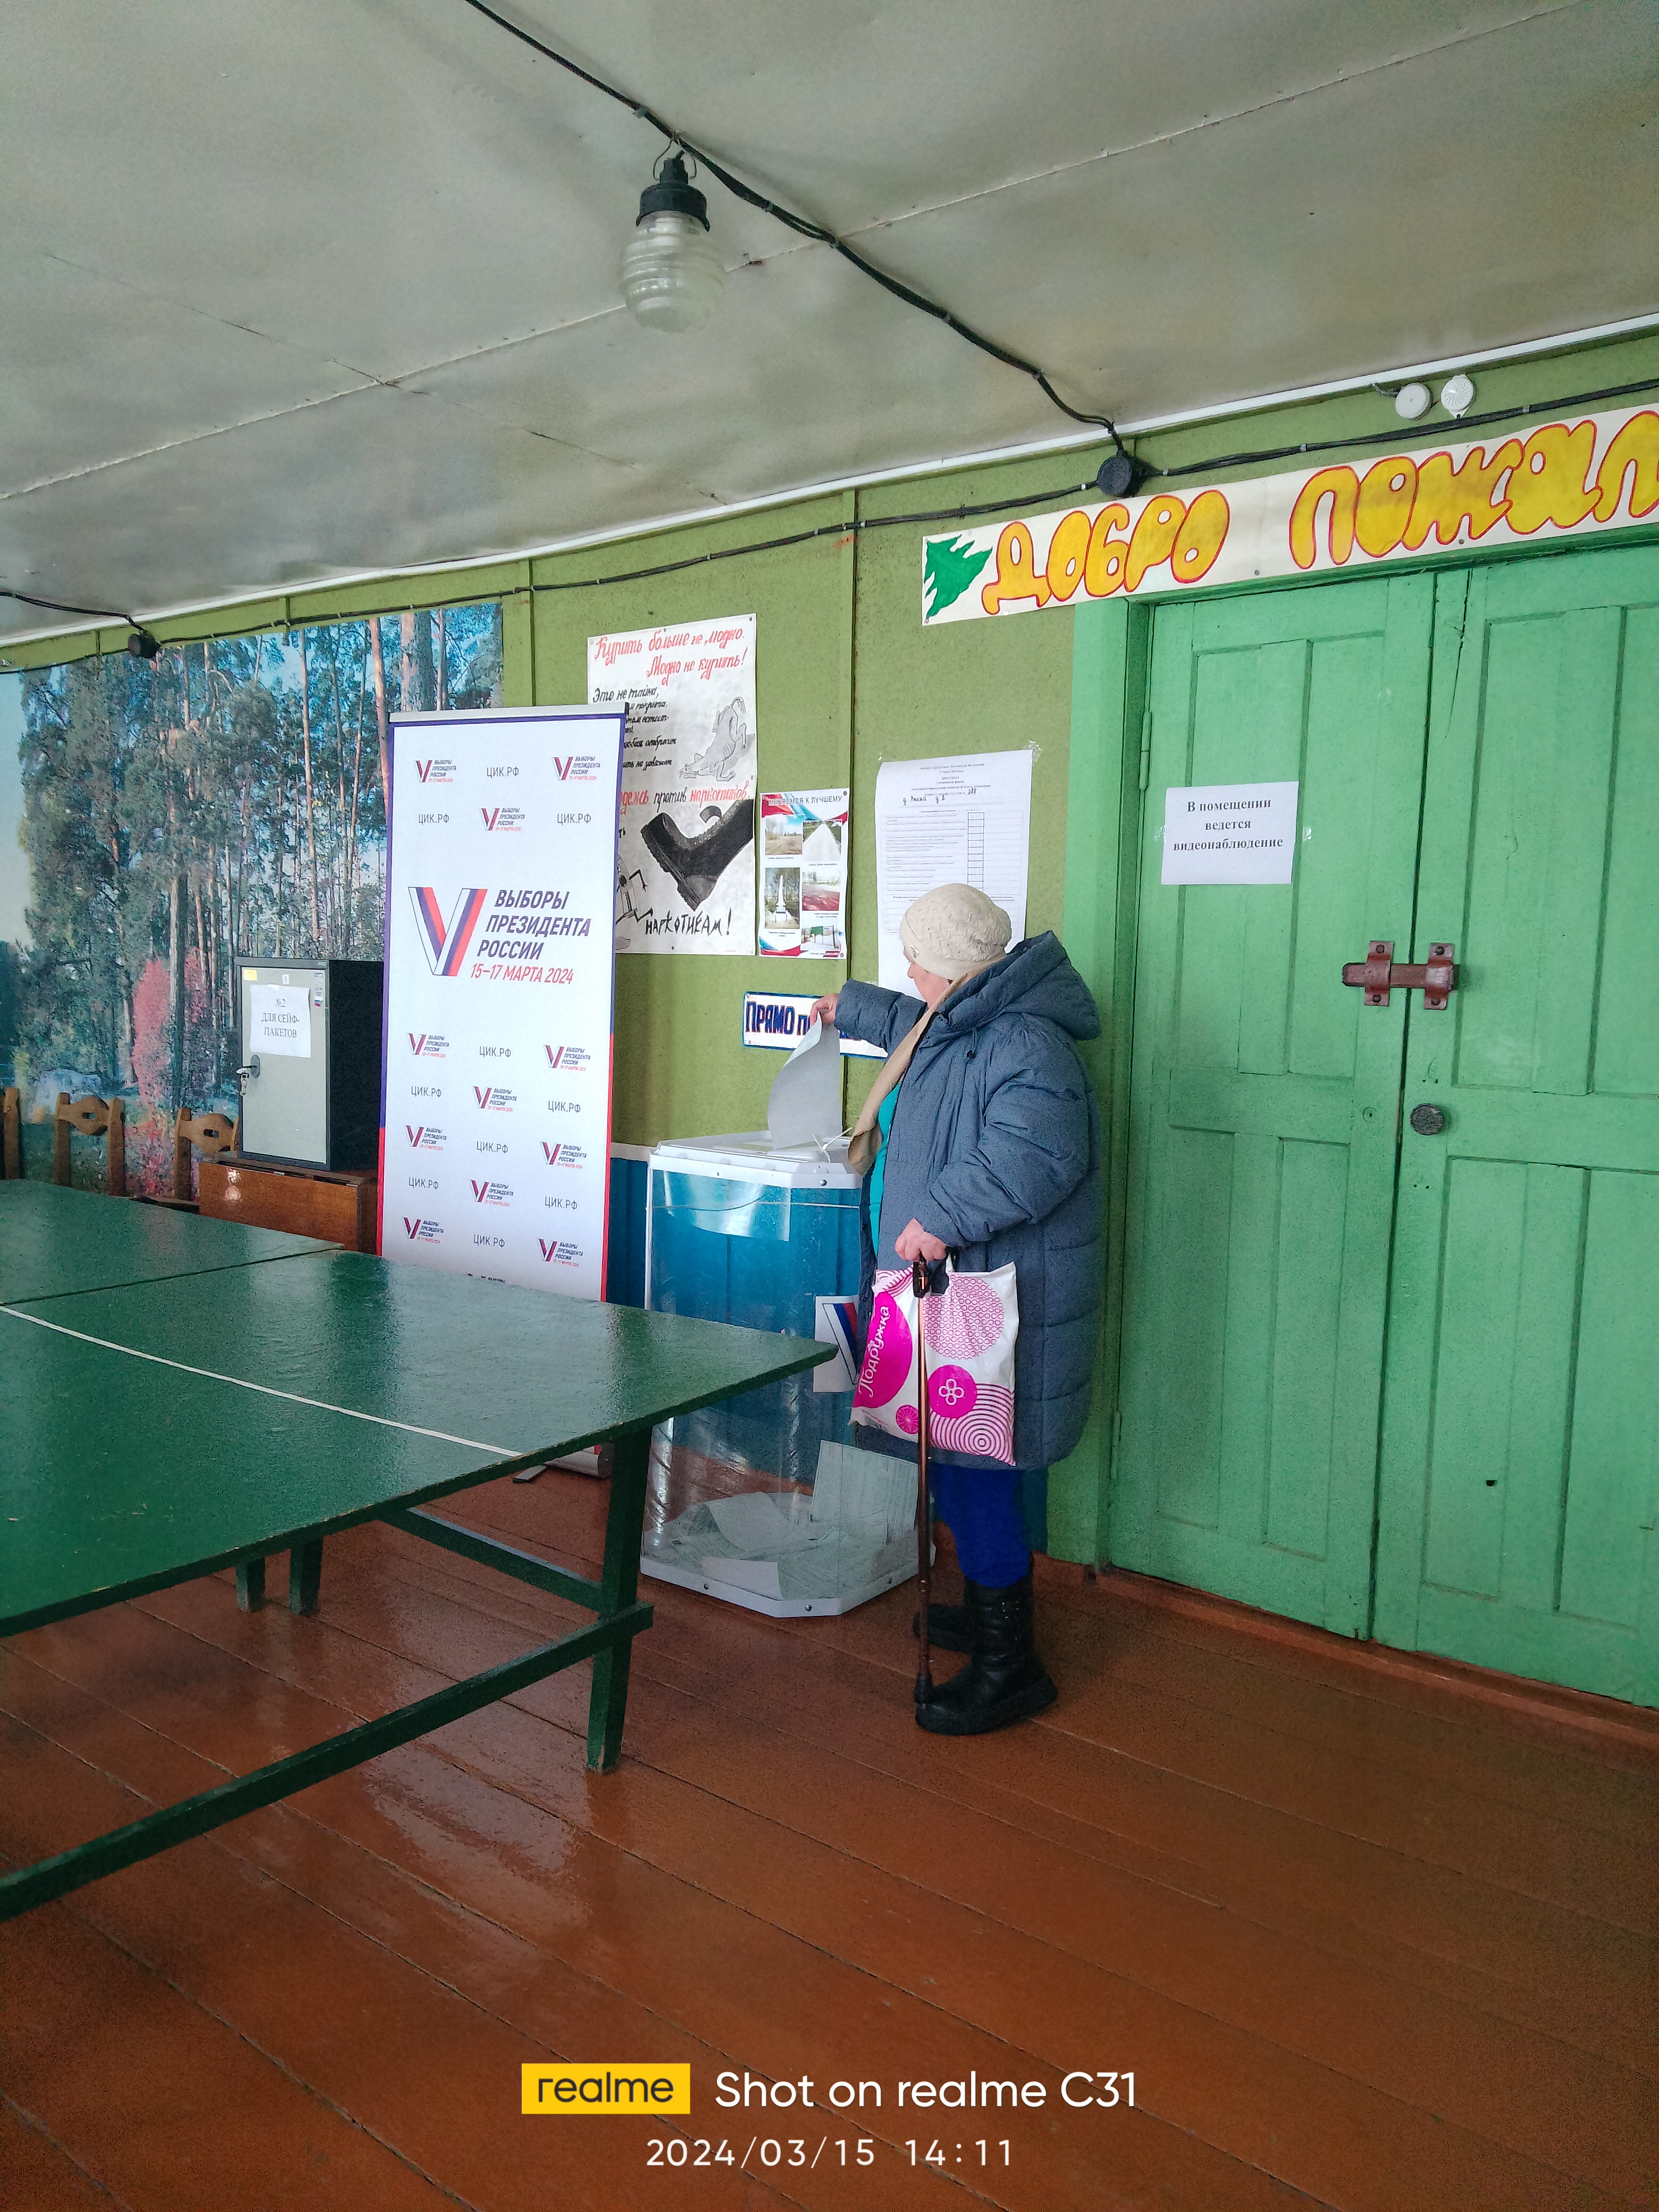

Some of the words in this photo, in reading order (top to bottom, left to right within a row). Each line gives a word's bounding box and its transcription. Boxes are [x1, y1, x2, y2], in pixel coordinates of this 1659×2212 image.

[982, 489, 1230, 615] ДОБРО
[594, 636, 643, 666] Курить
[648, 630, 690, 651] больше
[691, 634, 703, 645] не
[647, 655, 681, 686] Модно
[684, 660, 695, 672] не
[592, 687, 615, 703] Это
[616, 689, 627, 700] не
[487, 766, 520, 778] ЦИК.РФ
[653, 786, 688, 813] против
[811, 795, 842, 804] ЛУЧШЕМУ
[1187, 801, 1196, 812] В
[1200, 799, 1271, 812] помещении
[418, 814, 449, 825] ЦИК.РФ
[557, 813, 591, 825] ЦИК.РФ
[1205, 820, 1251, 831] ведется
[1174, 838, 1283, 851] видеонаблюдение
[494, 889, 571, 910] ВЫБОРЫ
[485, 915, 591, 938] ПРЕЗИДЕНТА
[477, 940, 544, 960] РОССИИ
[504, 965, 542, 982] МАРТА
[544, 967, 574, 985] 2024
[262, 1012, 276, 1023] ДЛЯ
[264, 1027, 297, 1038] ПАКЕТОВ
[480, 1046, 512, 1058] ЦИК.РФ
[411, 1086, 442, 1097] ЦИК.РФ
[548, 1100, 581, 1113] ЦИК.РФ
[476, 1141, 508, 1154] ЦИК.РФ
[408, 1177, 439, 1189] ЦИК.РФ
[544, 1196, 578, 1210] ЦИК.РФ
[474, 1234, 505, 1248] ЦИК.РФ
[858, 1305, 890, 1398] Подружка
